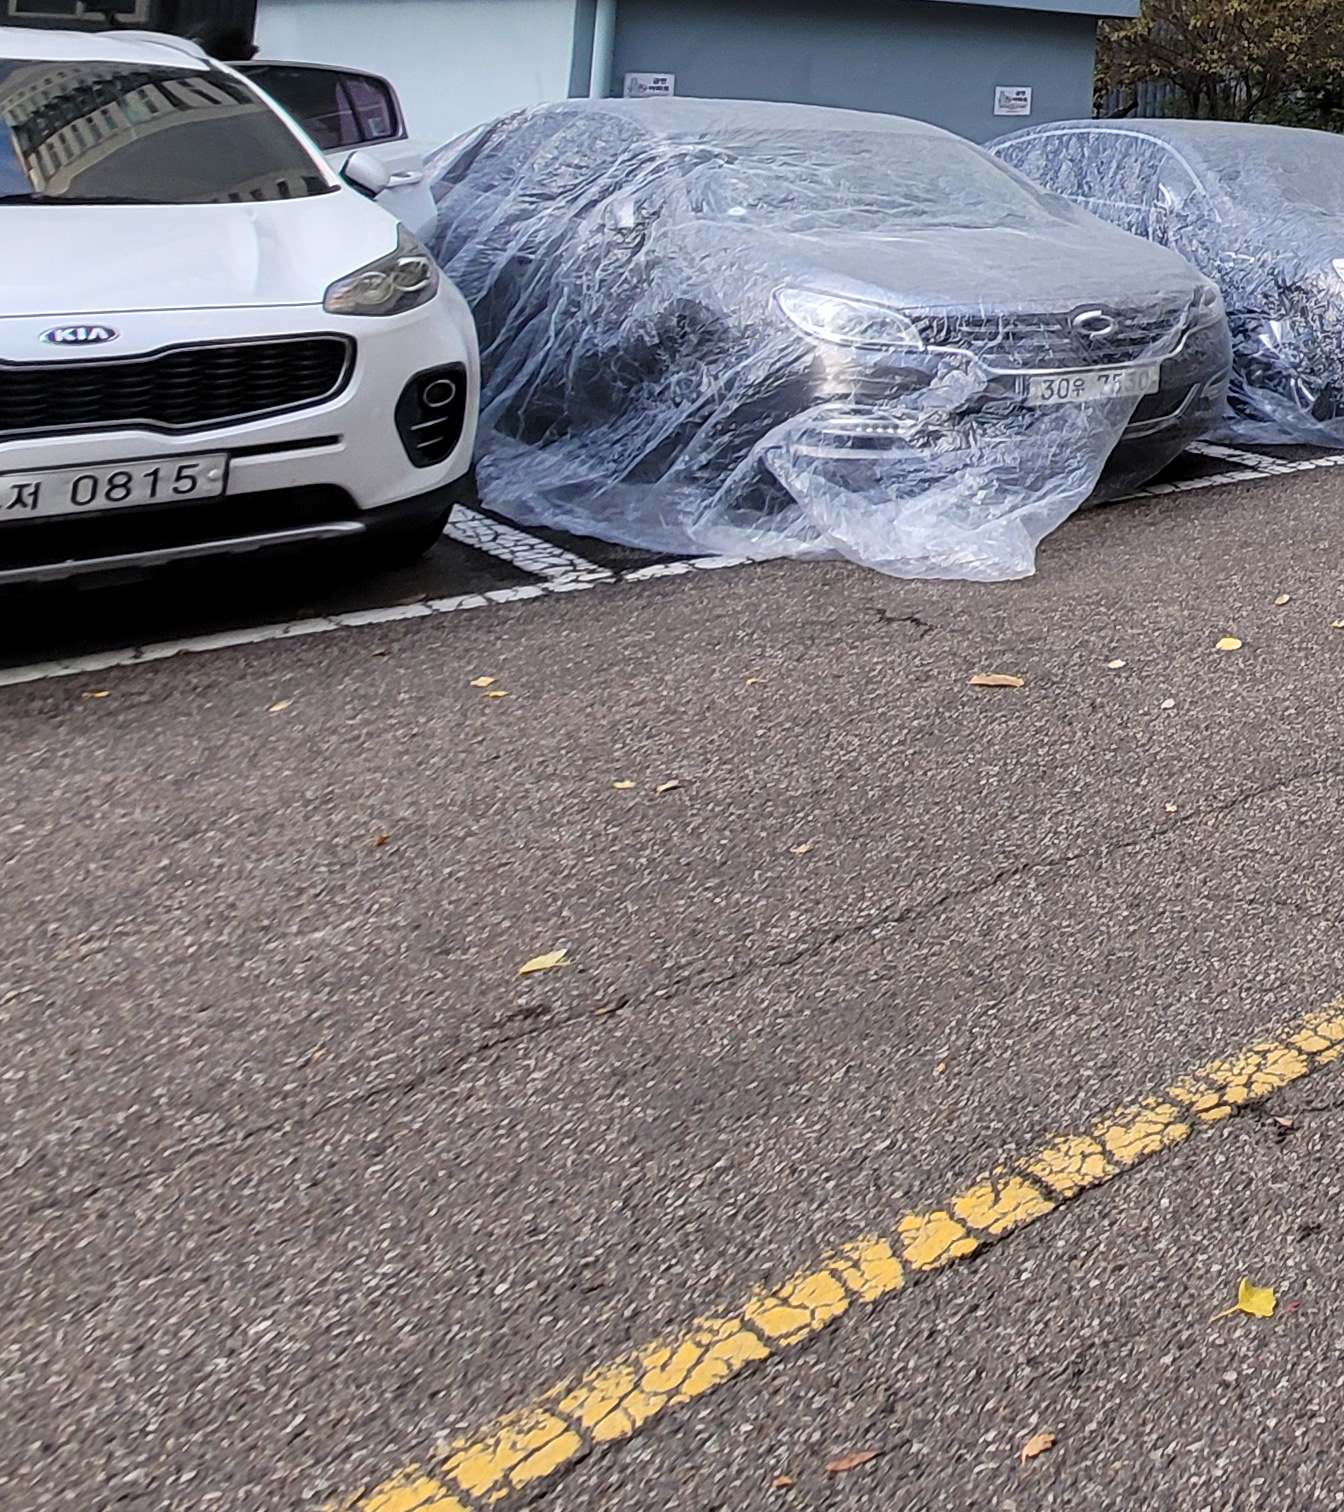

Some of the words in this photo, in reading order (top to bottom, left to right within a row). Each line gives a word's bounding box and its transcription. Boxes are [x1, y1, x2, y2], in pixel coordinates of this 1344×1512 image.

[51, 326, 111, 343] KIA
[1040, 377, 1086, 401] 30우
[0, 481, 42, 511] 저
[70, 463, 200, 506] 0815
